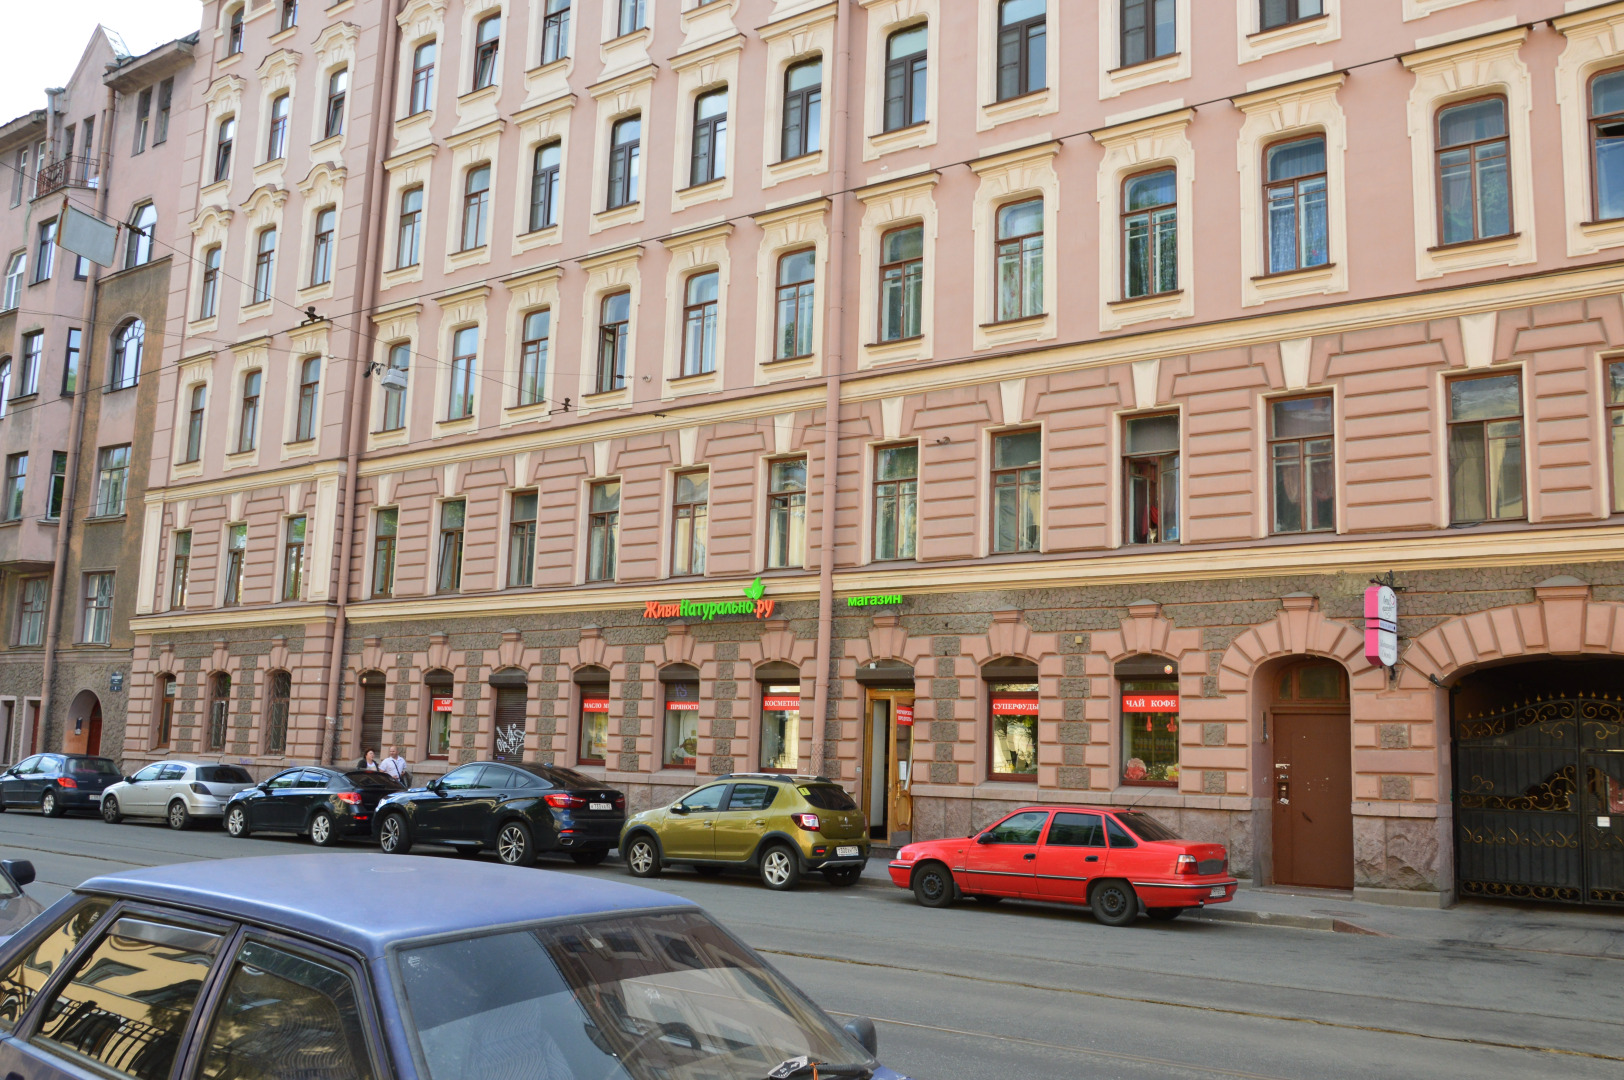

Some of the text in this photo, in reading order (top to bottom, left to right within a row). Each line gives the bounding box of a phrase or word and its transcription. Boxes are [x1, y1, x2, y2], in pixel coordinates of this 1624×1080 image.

[848, 594, 902, 607] магазин
[643, 598, 774, 621] ЖивиНатурально.ру
[993, 703, 1039, 711] СУПЕРФУДЫ
[1126, 698, 1176, 707] ЧАЙ КОФЕ
